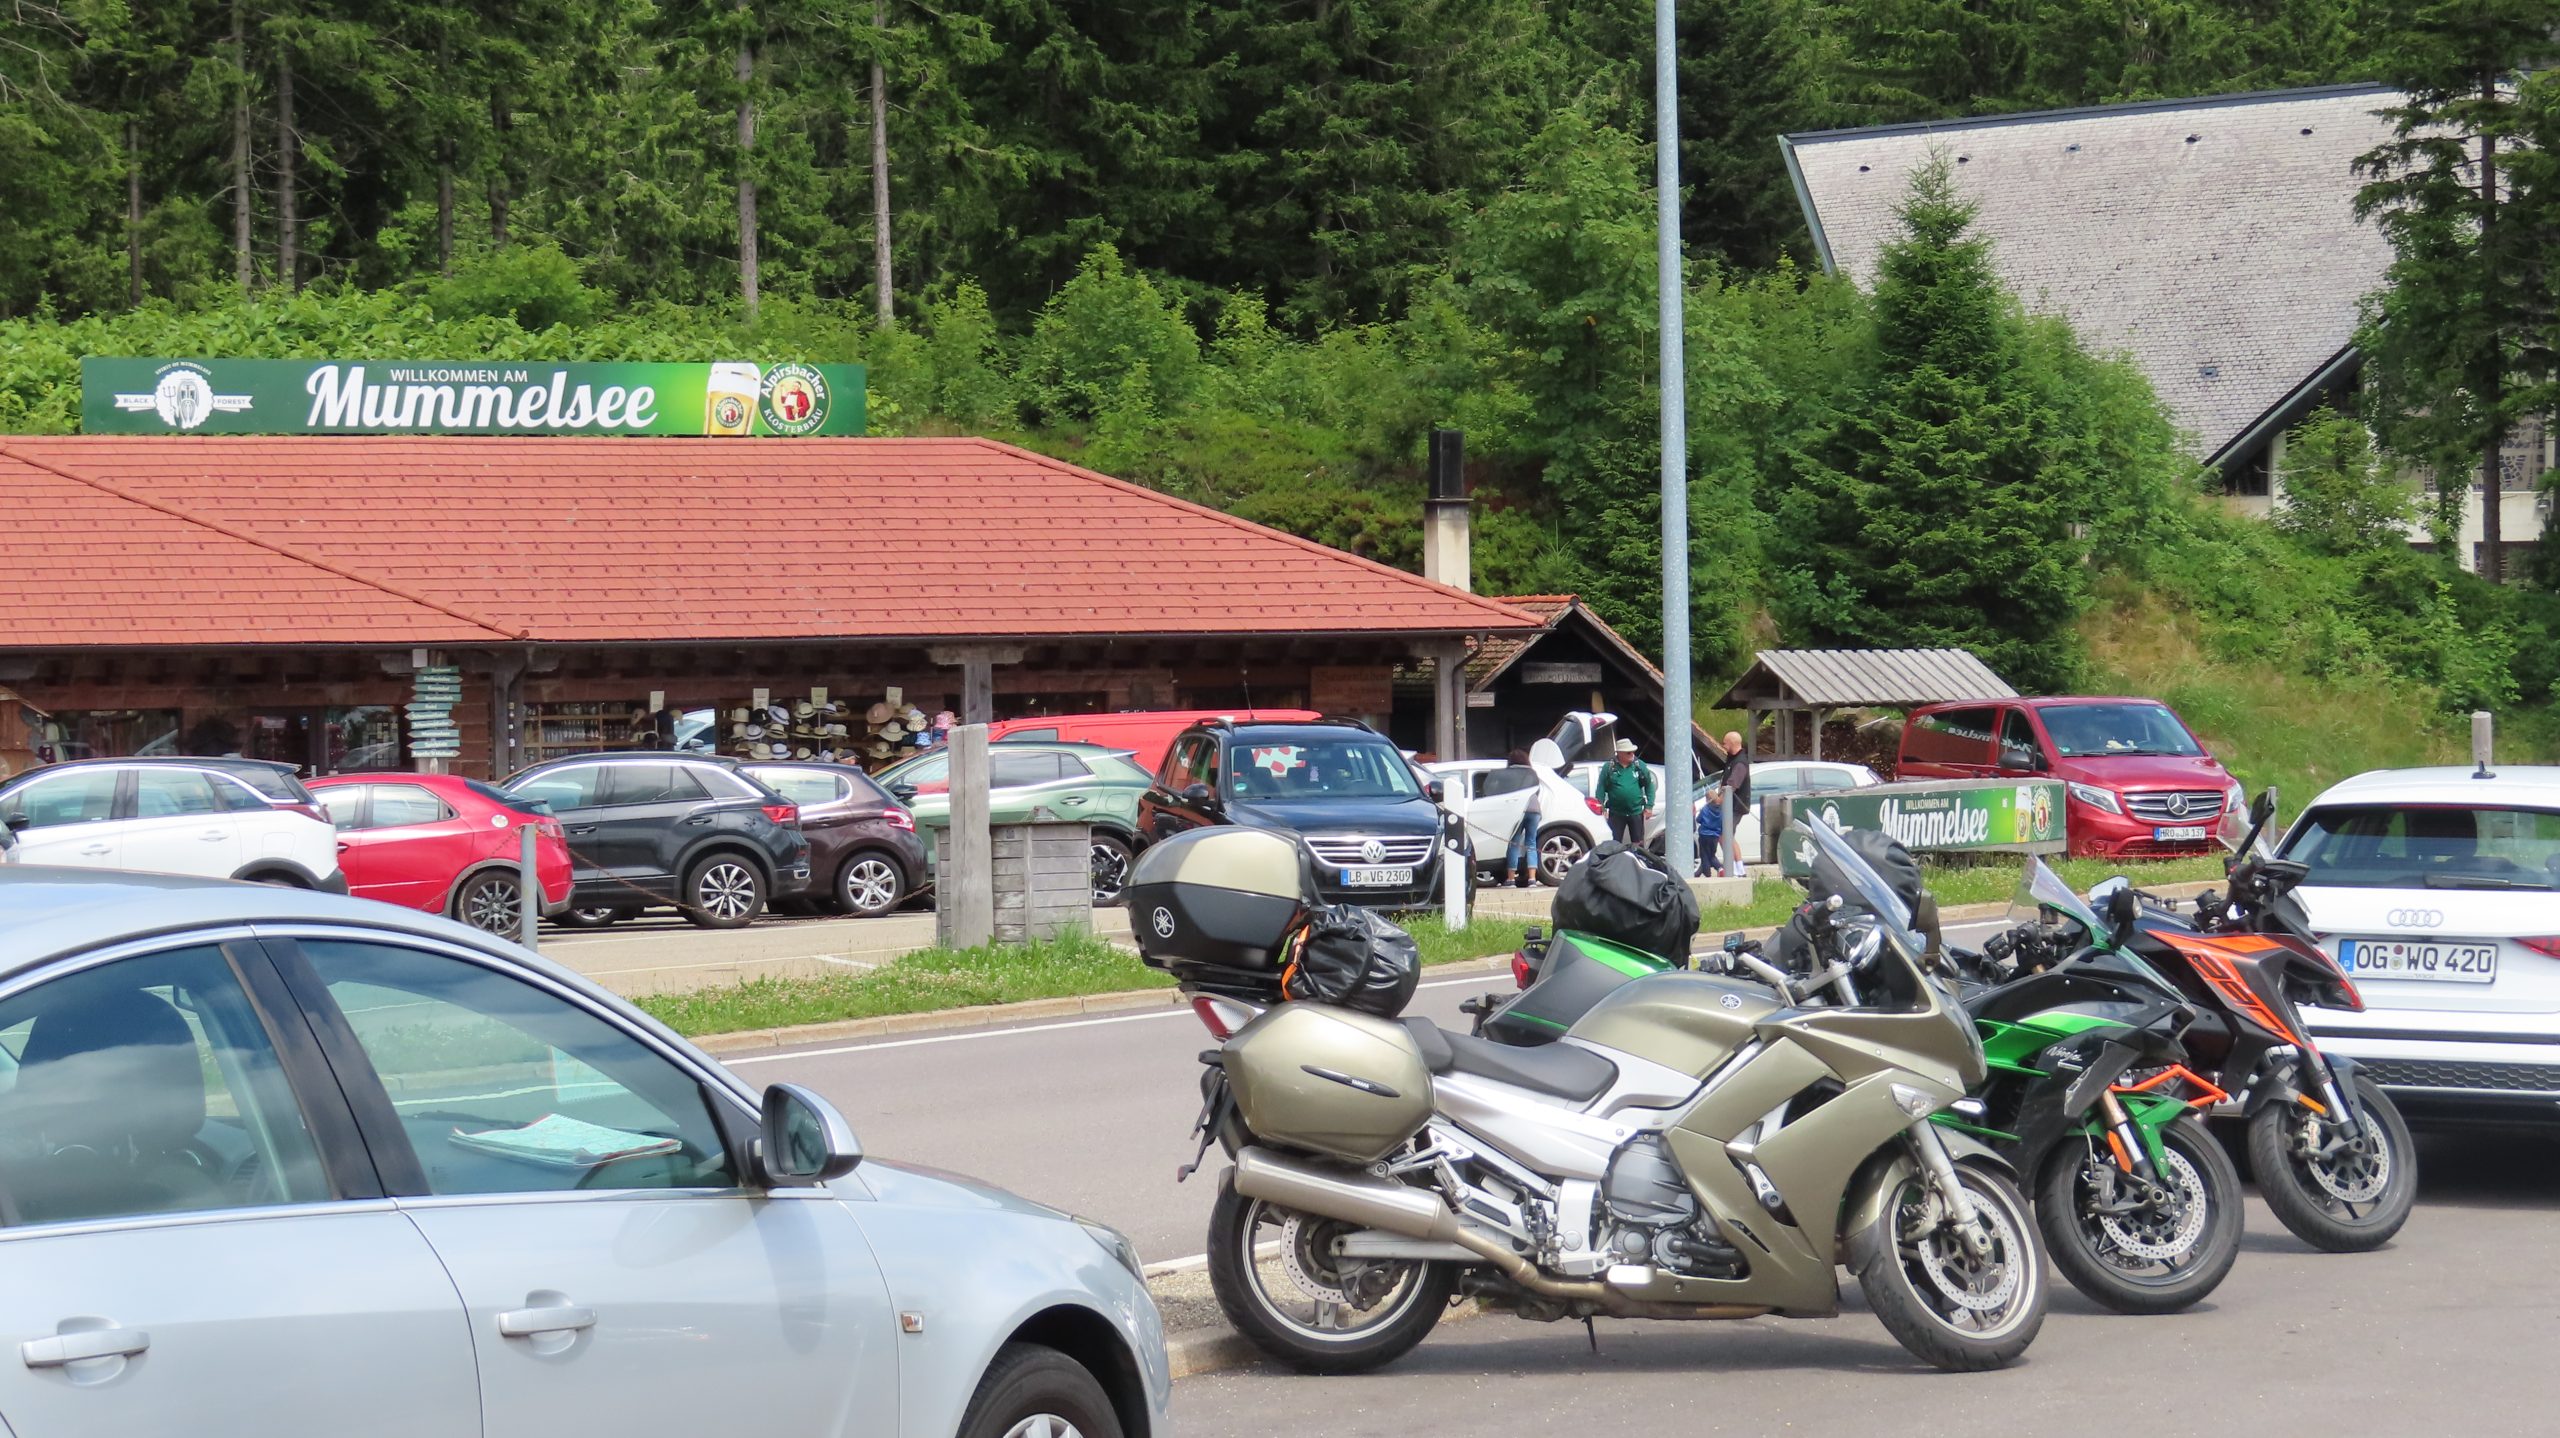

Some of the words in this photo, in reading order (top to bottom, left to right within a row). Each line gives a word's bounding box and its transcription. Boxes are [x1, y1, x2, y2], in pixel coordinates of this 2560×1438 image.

[391, 369, 498, 382] WILLKOMMEN
[503, 369, 528, 382] AM
[761, 363, 826, 399] Alpirsbacher
[305, 364, 659, 428] Mummelsee
[764, 408, 824, 433] KLOSTERBRÄU
[1905, 799, 1939, 810] WILLKOMMEN
[1940, 798, 1949, 808] AM
[1879, 797, 1989, 848] Mummelsee
[2191, 827, 2204, 838] 137
[1349, 871, 1362, 882] LB
[1370, 870, 1384, 882] VG
[1386, 870, 1411, 882] 2309
[2356, 944, 2388, 969] OG
[2406, 946, 2439, 971] WQ
[2444, 948, 2492, 973] 420
[2046, 1046, 2083, 1062] Ninja
